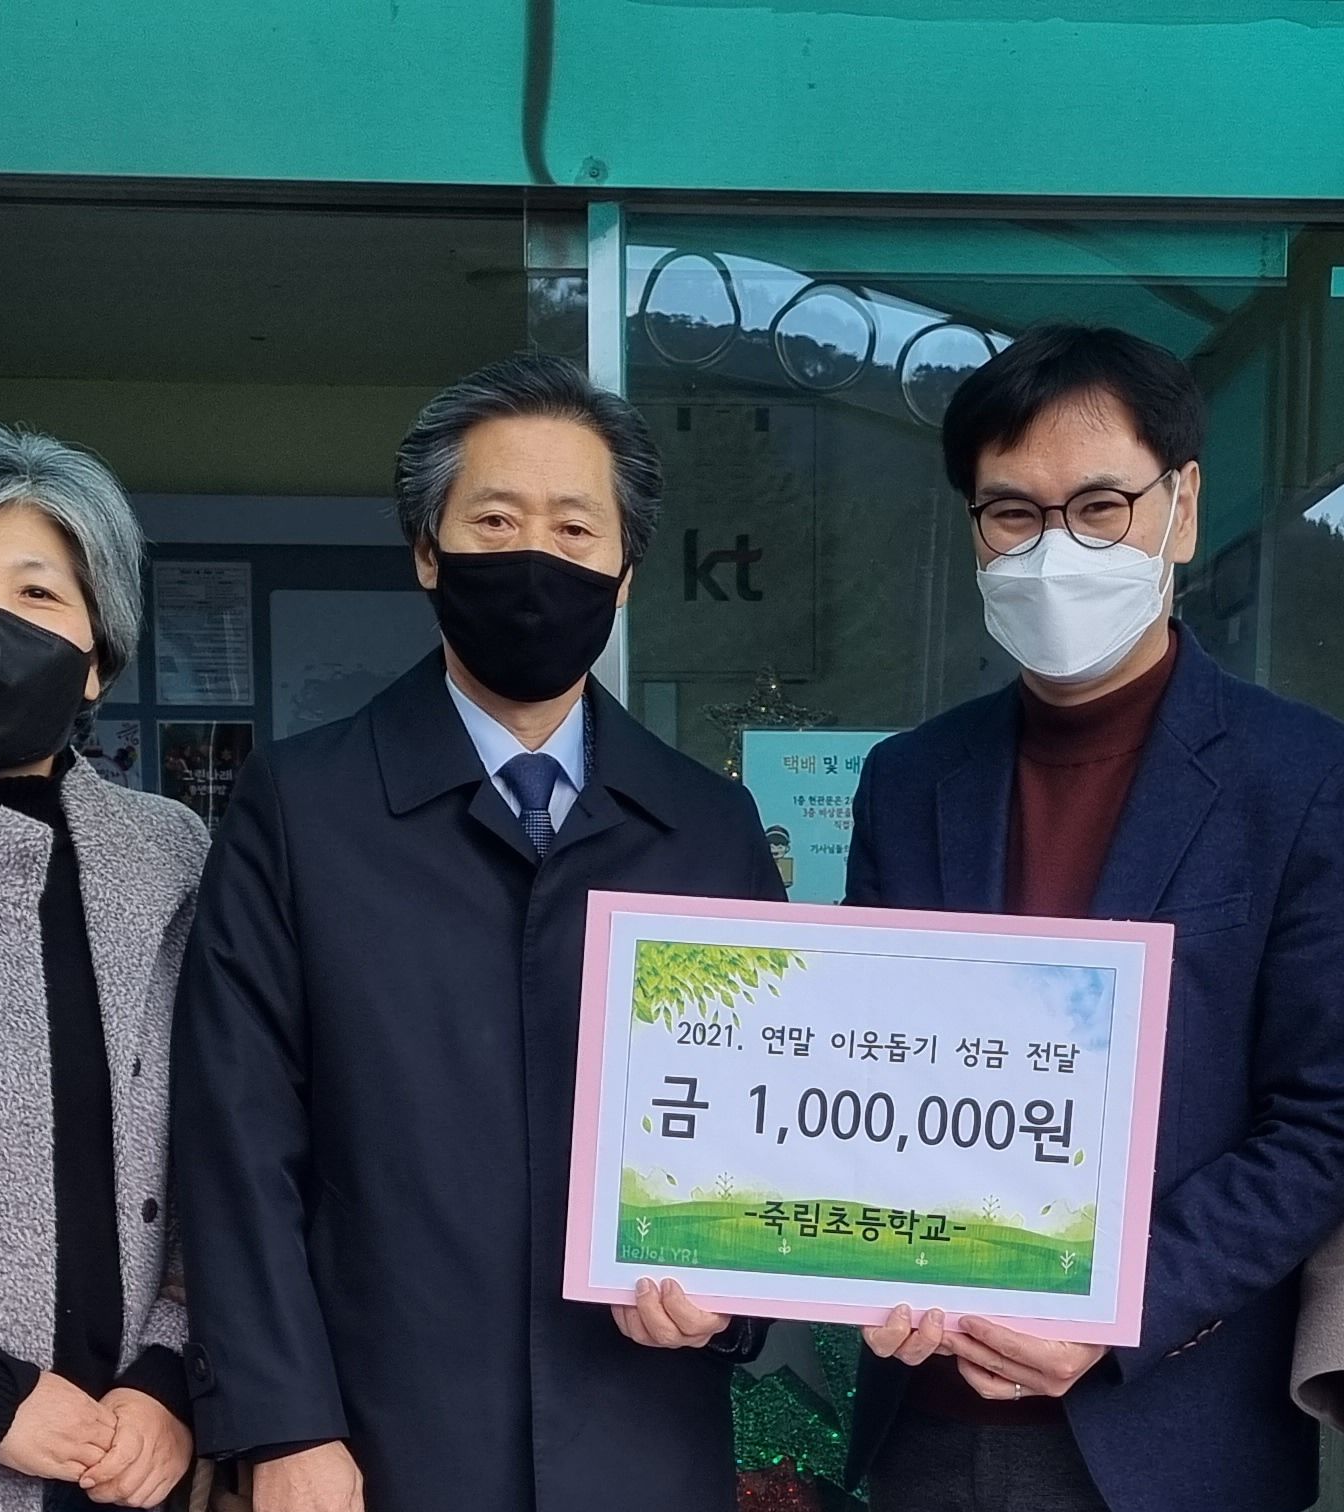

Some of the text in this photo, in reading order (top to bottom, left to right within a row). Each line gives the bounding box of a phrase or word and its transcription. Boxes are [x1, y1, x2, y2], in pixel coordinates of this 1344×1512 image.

[683, 529, 763, 602] kt
[783, 755, 865, 775] 택배 및 배
[676, 1021, 1080, 1073] 2021. 연말 이웃돕기 성금 전달
[651, 1076, 1074, 1164] 금 1,000,000원
